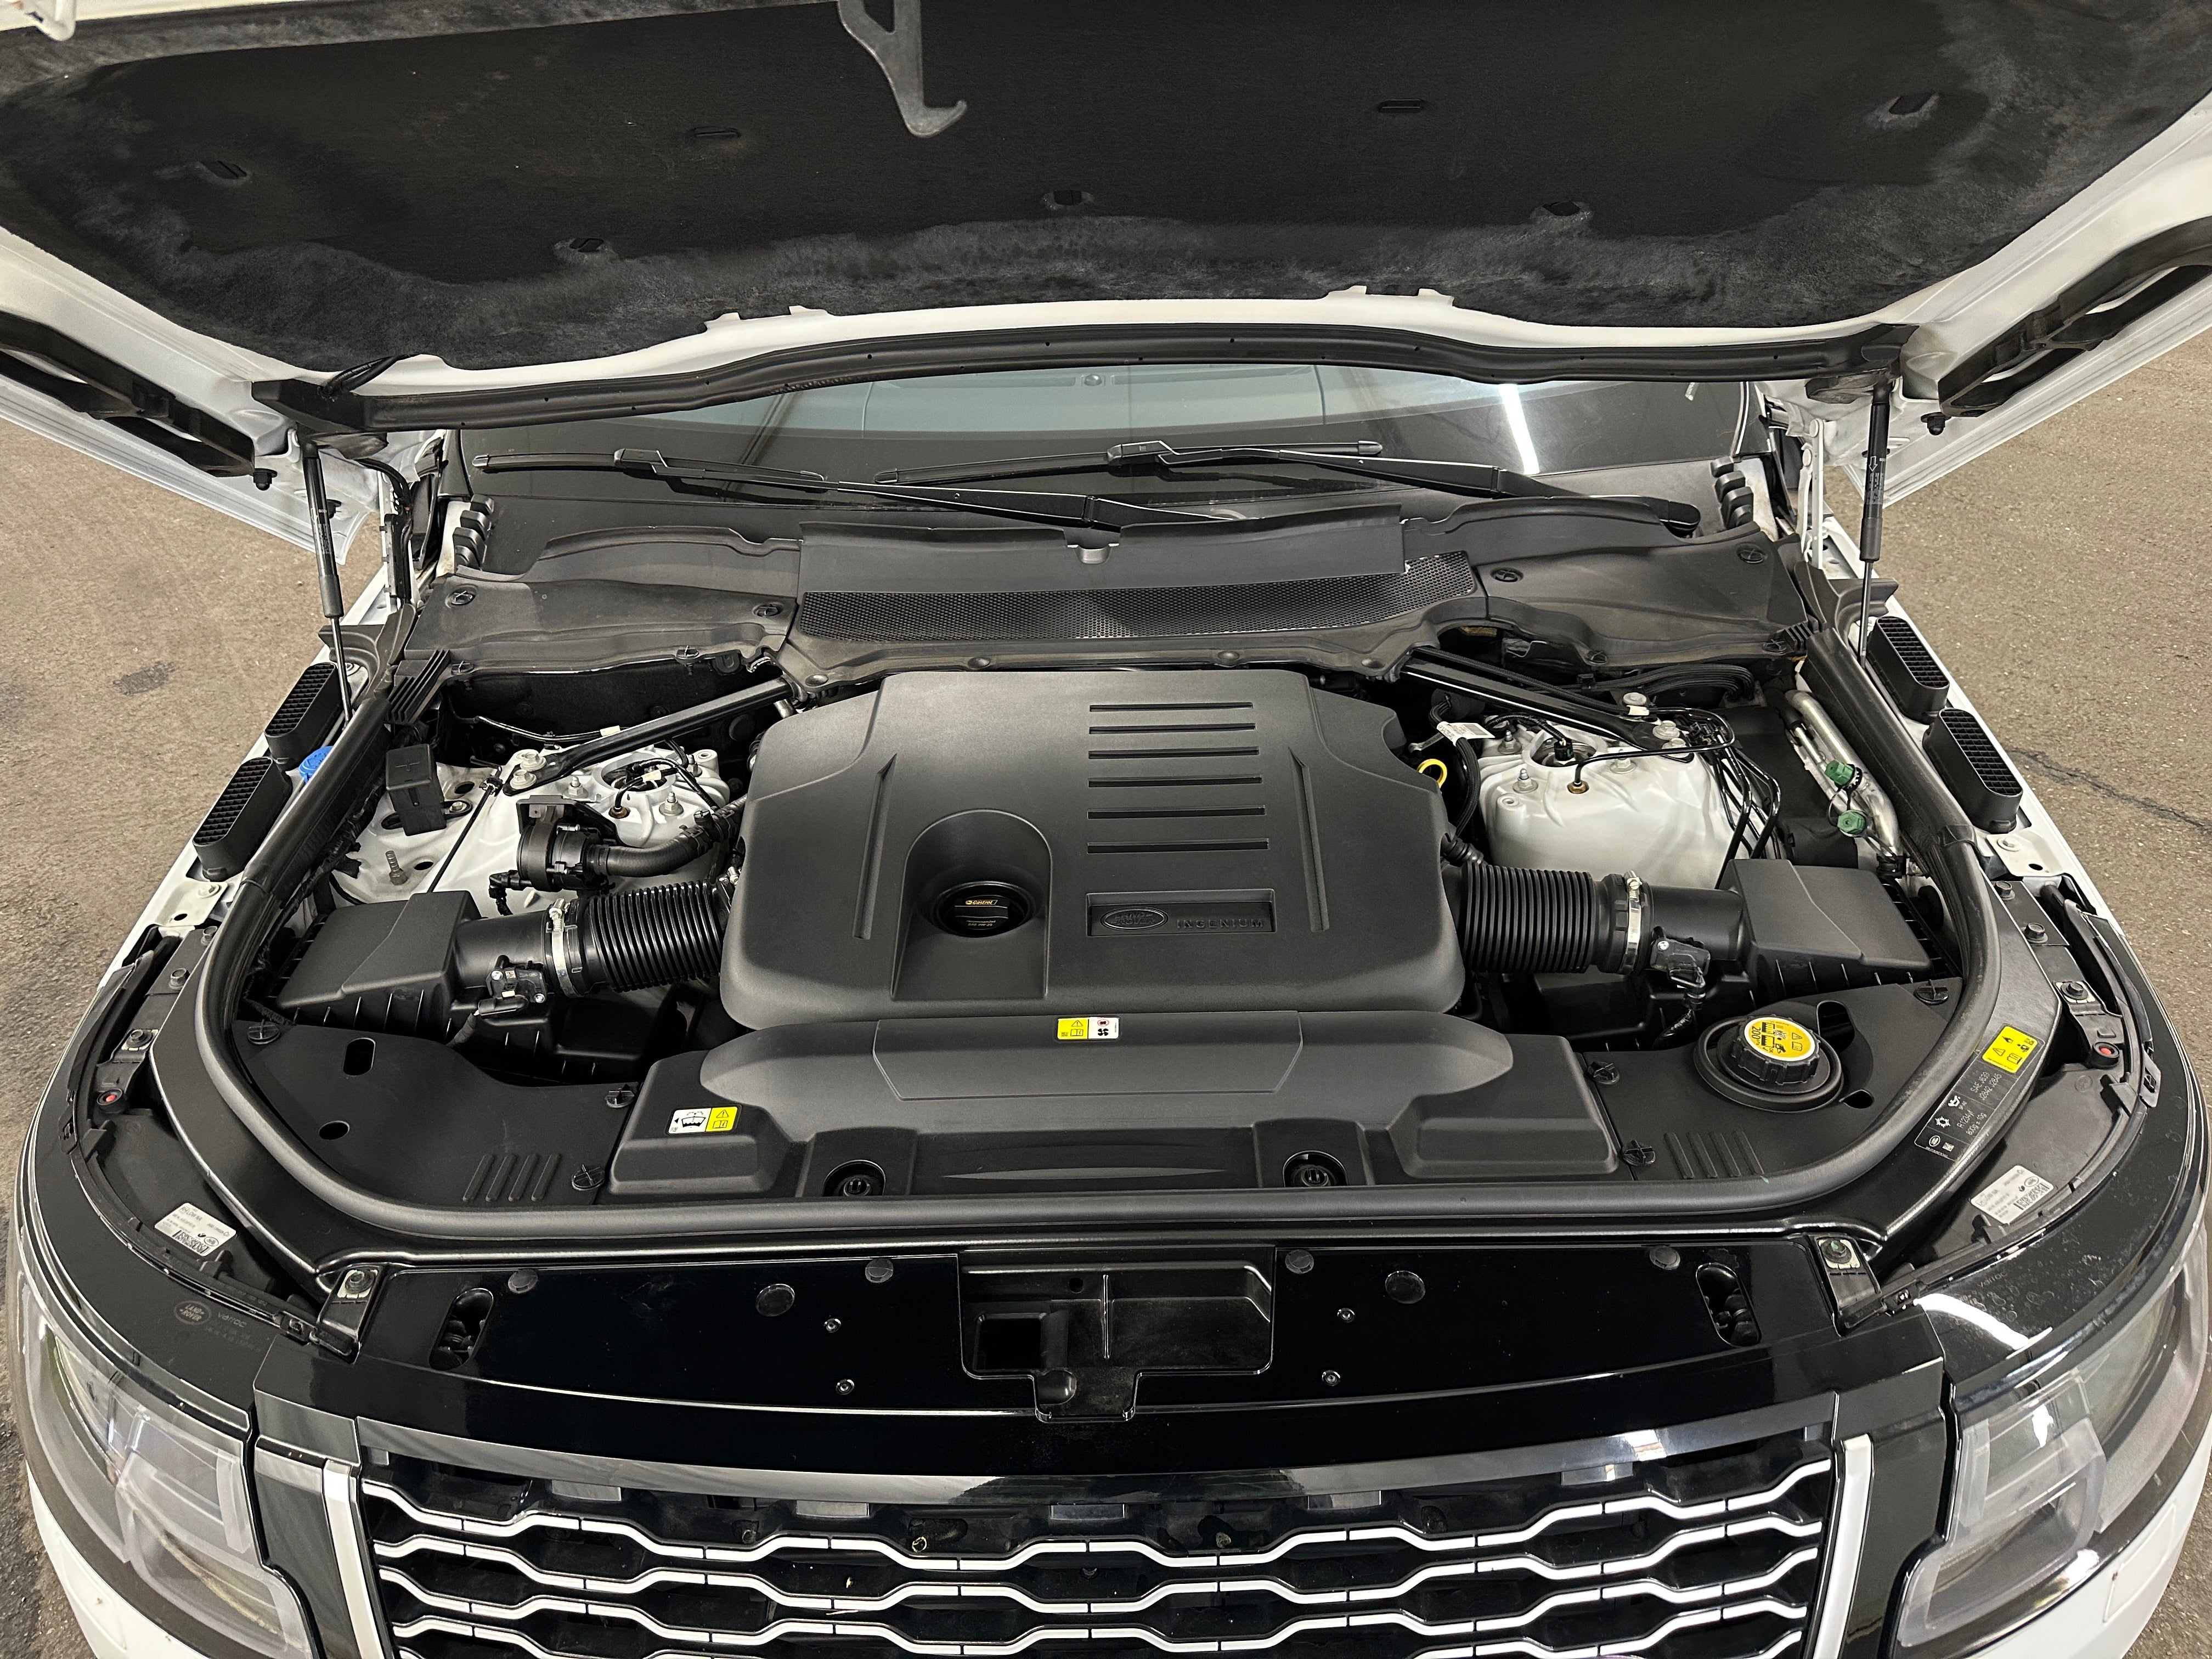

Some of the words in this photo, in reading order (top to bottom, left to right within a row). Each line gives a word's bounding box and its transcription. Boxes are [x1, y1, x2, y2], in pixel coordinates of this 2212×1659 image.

[1177, 918, 1264, 929] INGENIUM
[1752, 1026, 1760, 1040] 200
[1970, 1082, 1983, 1093] SAE
[1979, 1086, 1993, 1101] J2842
[1956, 1109, 1974, 1128] R1234yf
[1976, 1113, 1987, 1121] 10g
[185, 1304, 202, 1314] LAND
[182, 1310, 202, 1322] ROVER
[218, 1312, 247, 1328] varroc
